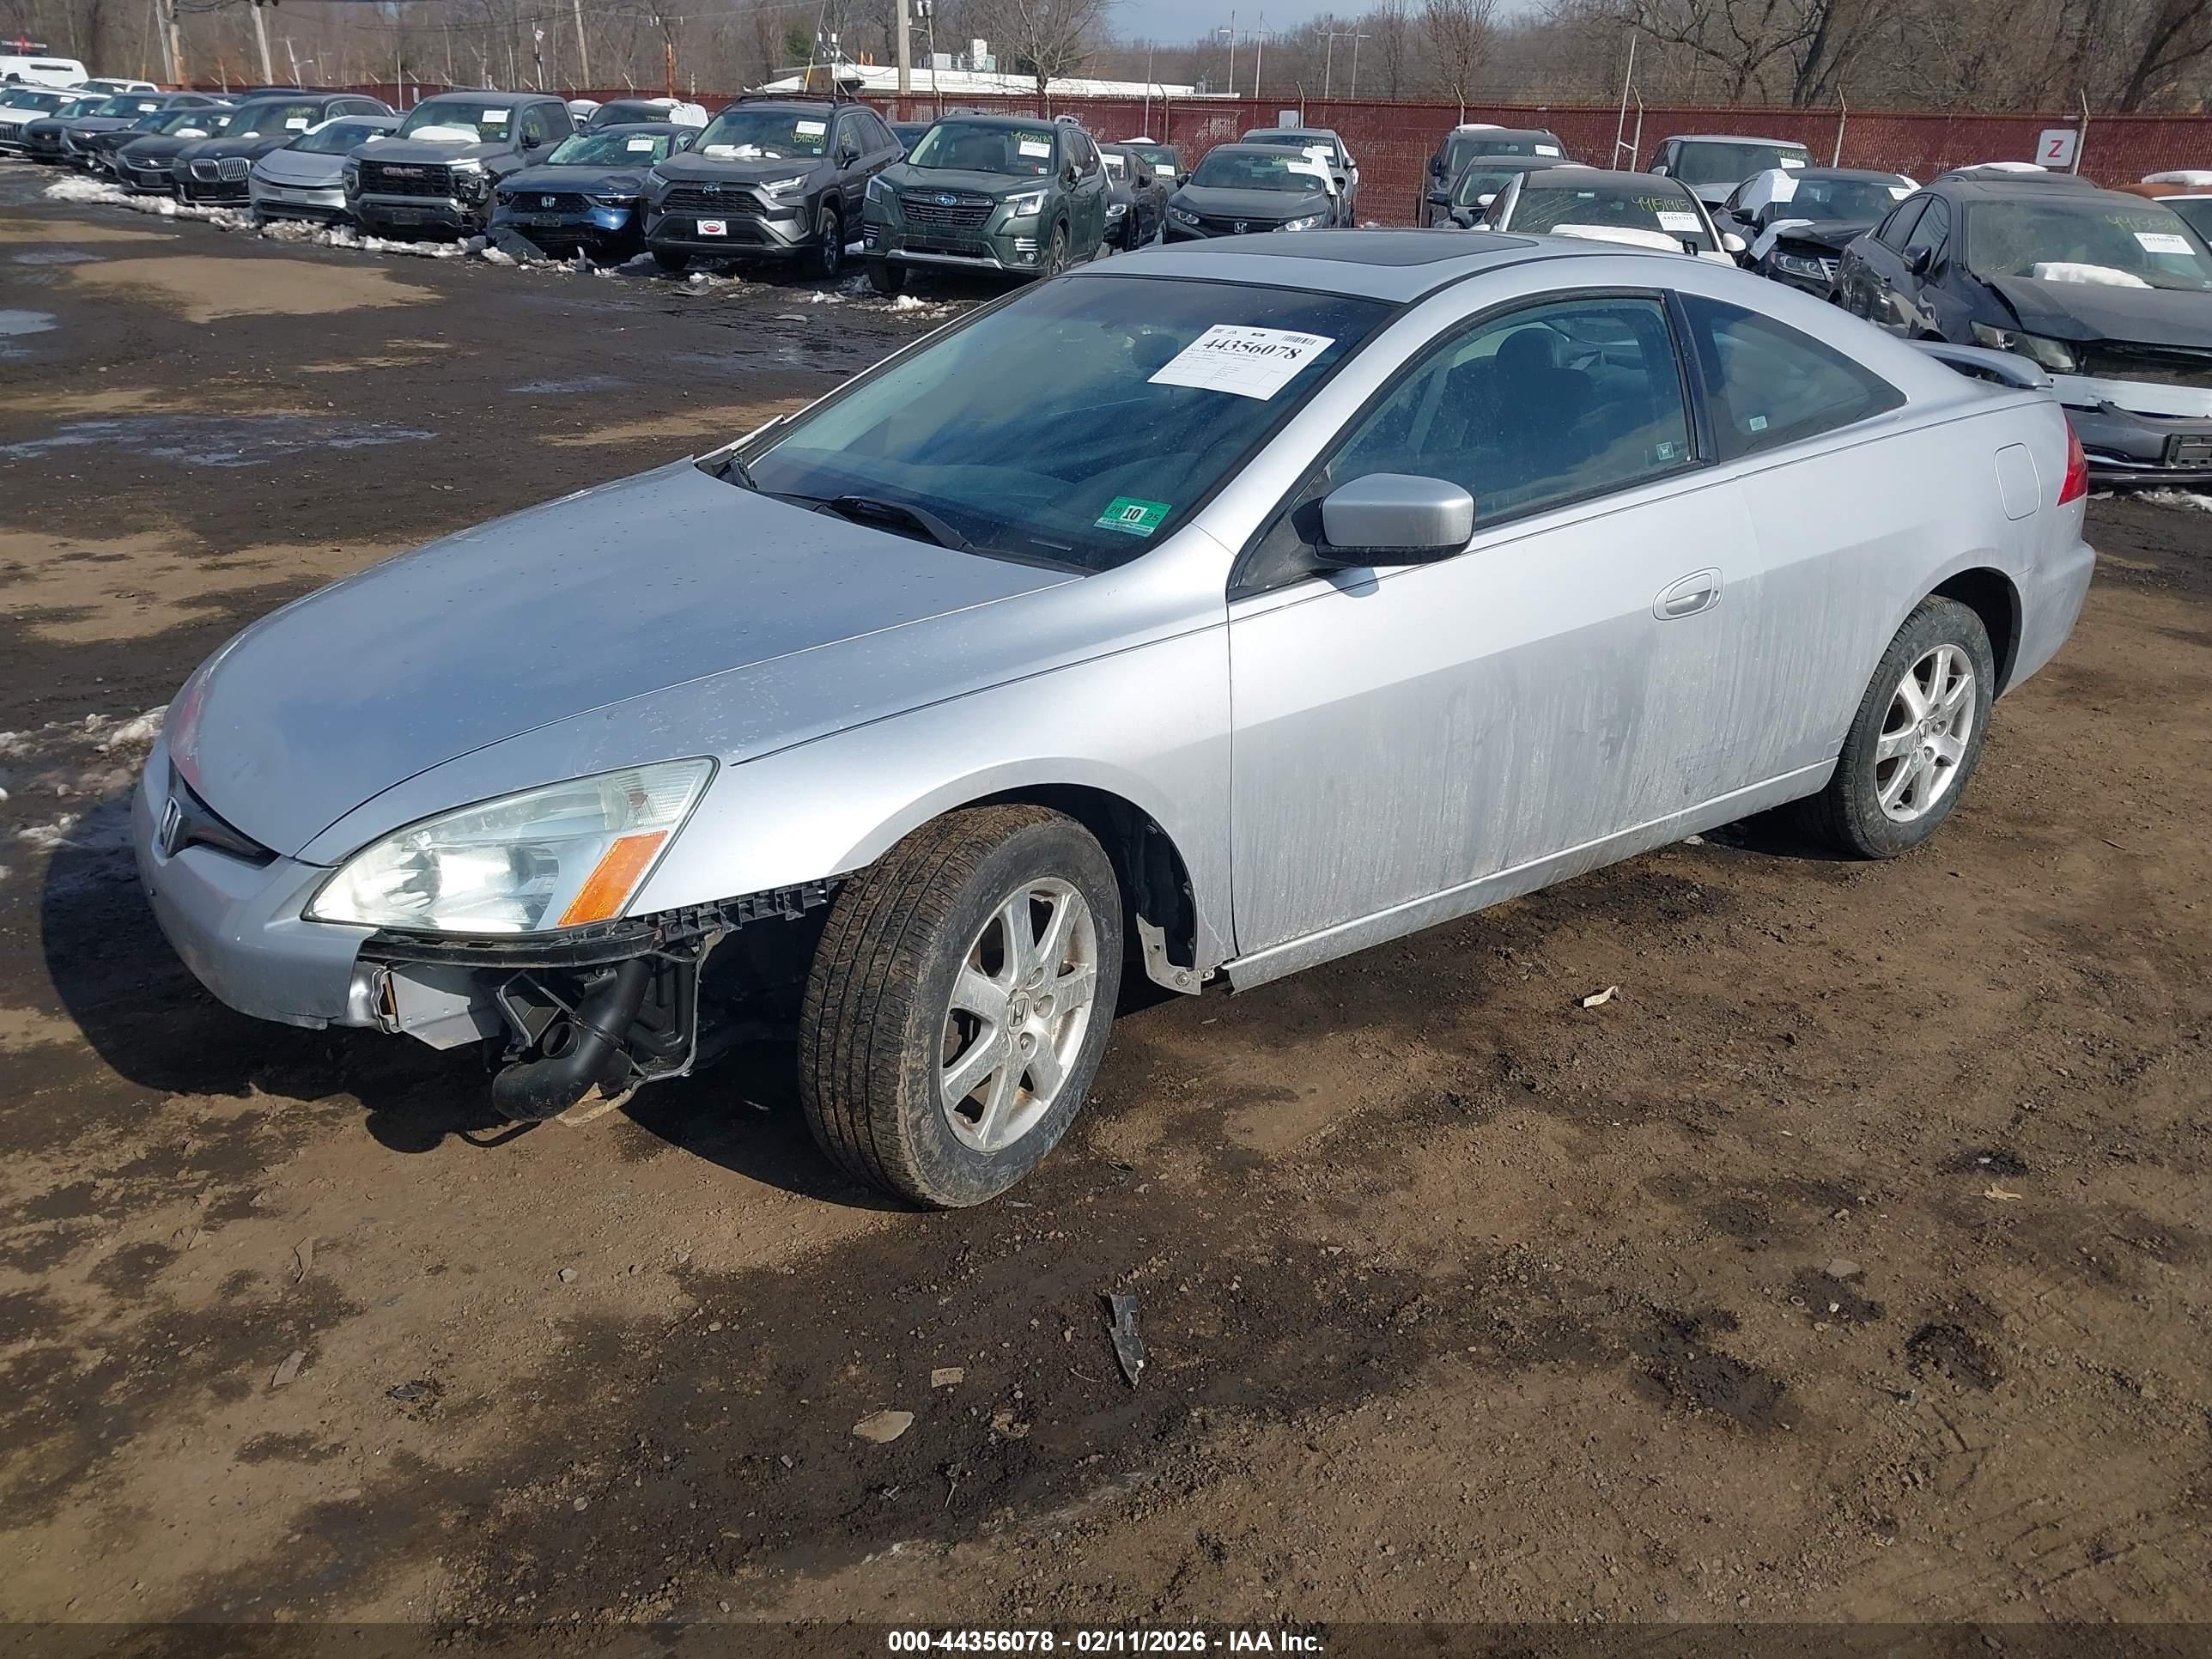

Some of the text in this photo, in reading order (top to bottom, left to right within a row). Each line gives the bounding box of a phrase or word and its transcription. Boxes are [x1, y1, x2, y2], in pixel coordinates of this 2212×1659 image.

[2047, 139, 2064, 158] Z
[382, 167, 423, 177] GMC
[1631, 195, 1692, 212] 44151915
[1203, 337, 1303, 360] 44356078
[1122, 507, 1141, 520] 10
[1145, 513, 1160, 522] 25
